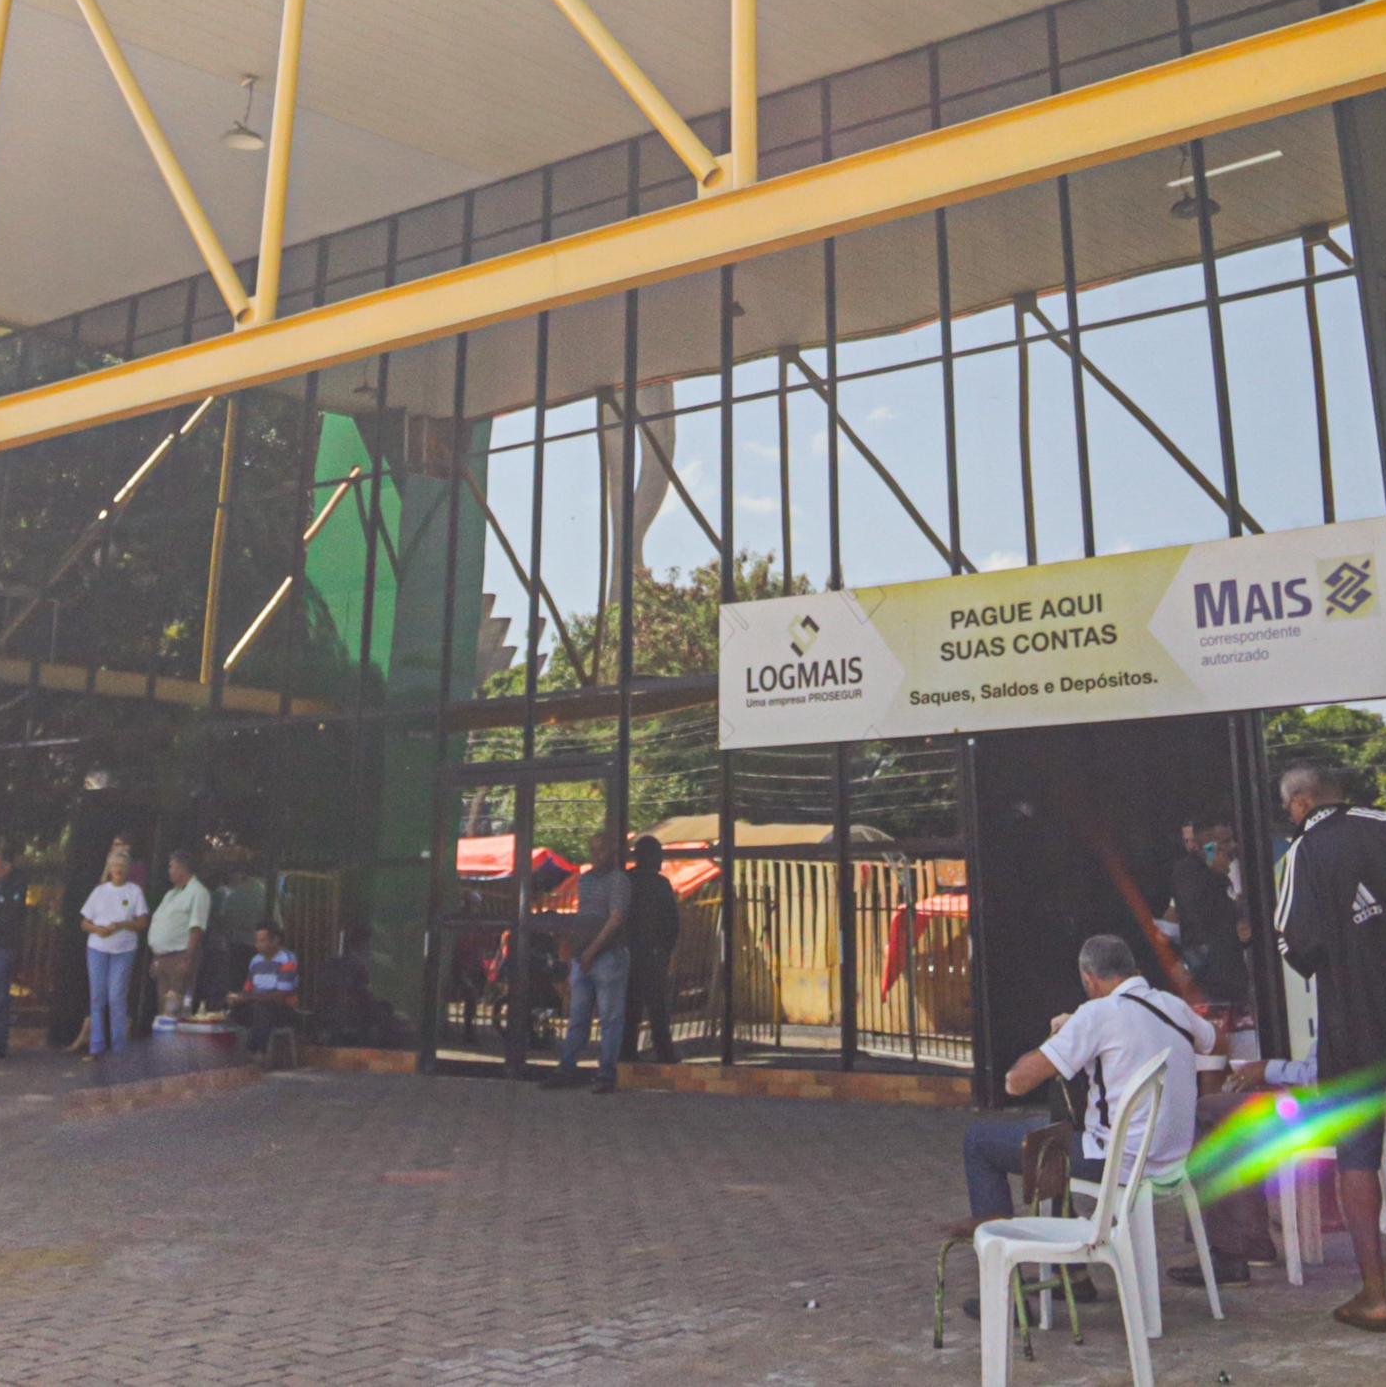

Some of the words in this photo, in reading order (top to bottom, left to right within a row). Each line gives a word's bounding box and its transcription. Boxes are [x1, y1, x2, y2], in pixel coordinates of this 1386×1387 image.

[950, 601, 1033, 630] PAGUE
[1039, 593, 1103, 620] AQUI
[1193, 578, 1313, 629] MAIS
[940, 636, 1006, 662] SUAS
[1013, 624, 1118, 655] CONTAS
[1199, 625, 1302, 647] correspondente
[746, 656, 863, 694] LOGMAIS
[1201, 647, 1270, 667] autorizado
[746, 696, 766, 708] Uma
[768, 695, 806, 708] empresa
[808, 689, 862, 702] PROSEGUR
[909, 690, 975, 707] Saques,
[980, 682, 1039, 700] Saldos
[1044, 682, 1055, 694] e
[1060, 671, 1159, 693] Depósitos.
